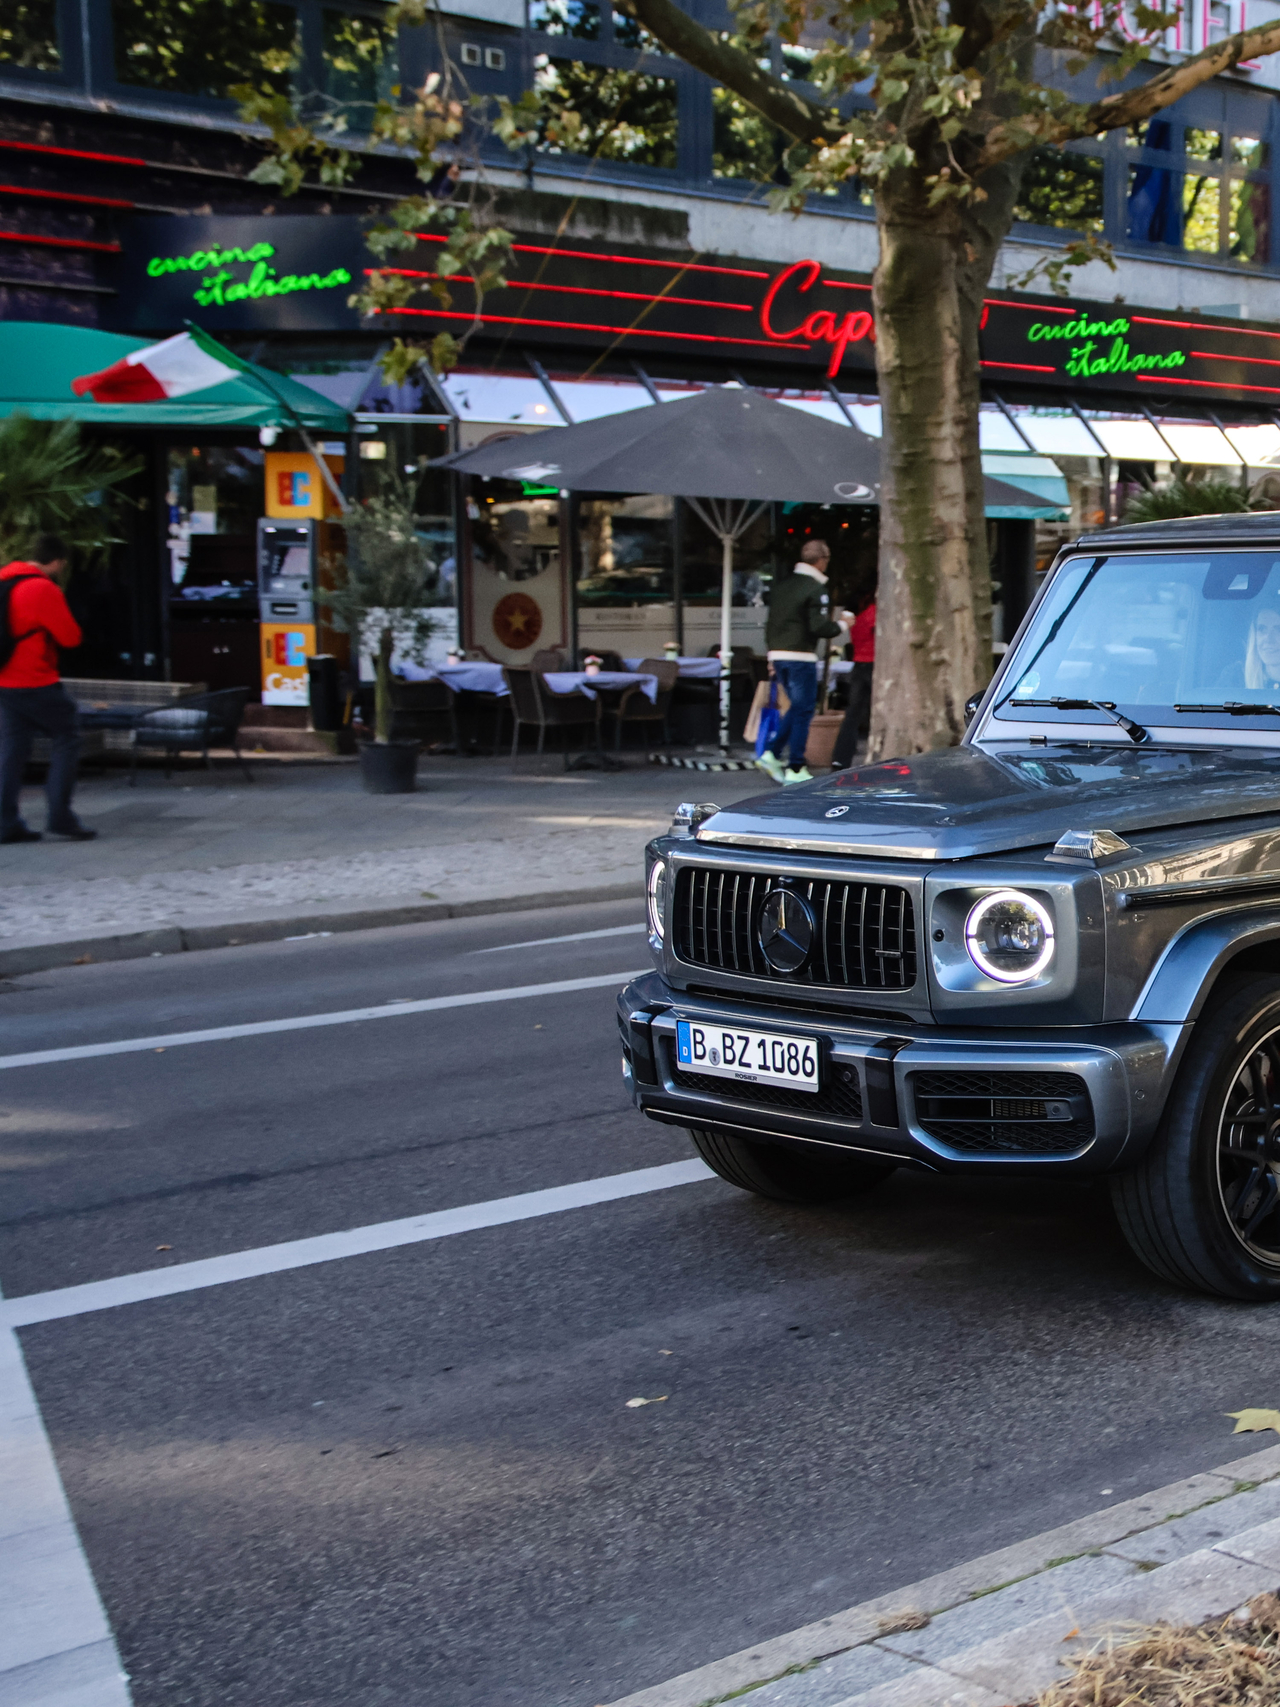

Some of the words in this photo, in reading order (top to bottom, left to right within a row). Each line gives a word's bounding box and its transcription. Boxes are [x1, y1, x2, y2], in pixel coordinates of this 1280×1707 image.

[147, 242, 274, 277] cucina
[193, 261, 351, 306] italiana
[1028, 313, 1130, 342] cucina
[1065, 337, 1186, 377] italiana
[683, 1046, 688, 1056] D
[693, 1028, 706, 1060] B
[722, 1033, 752, 1069] BZ
[757, 1038, 815, 1078] 1086
